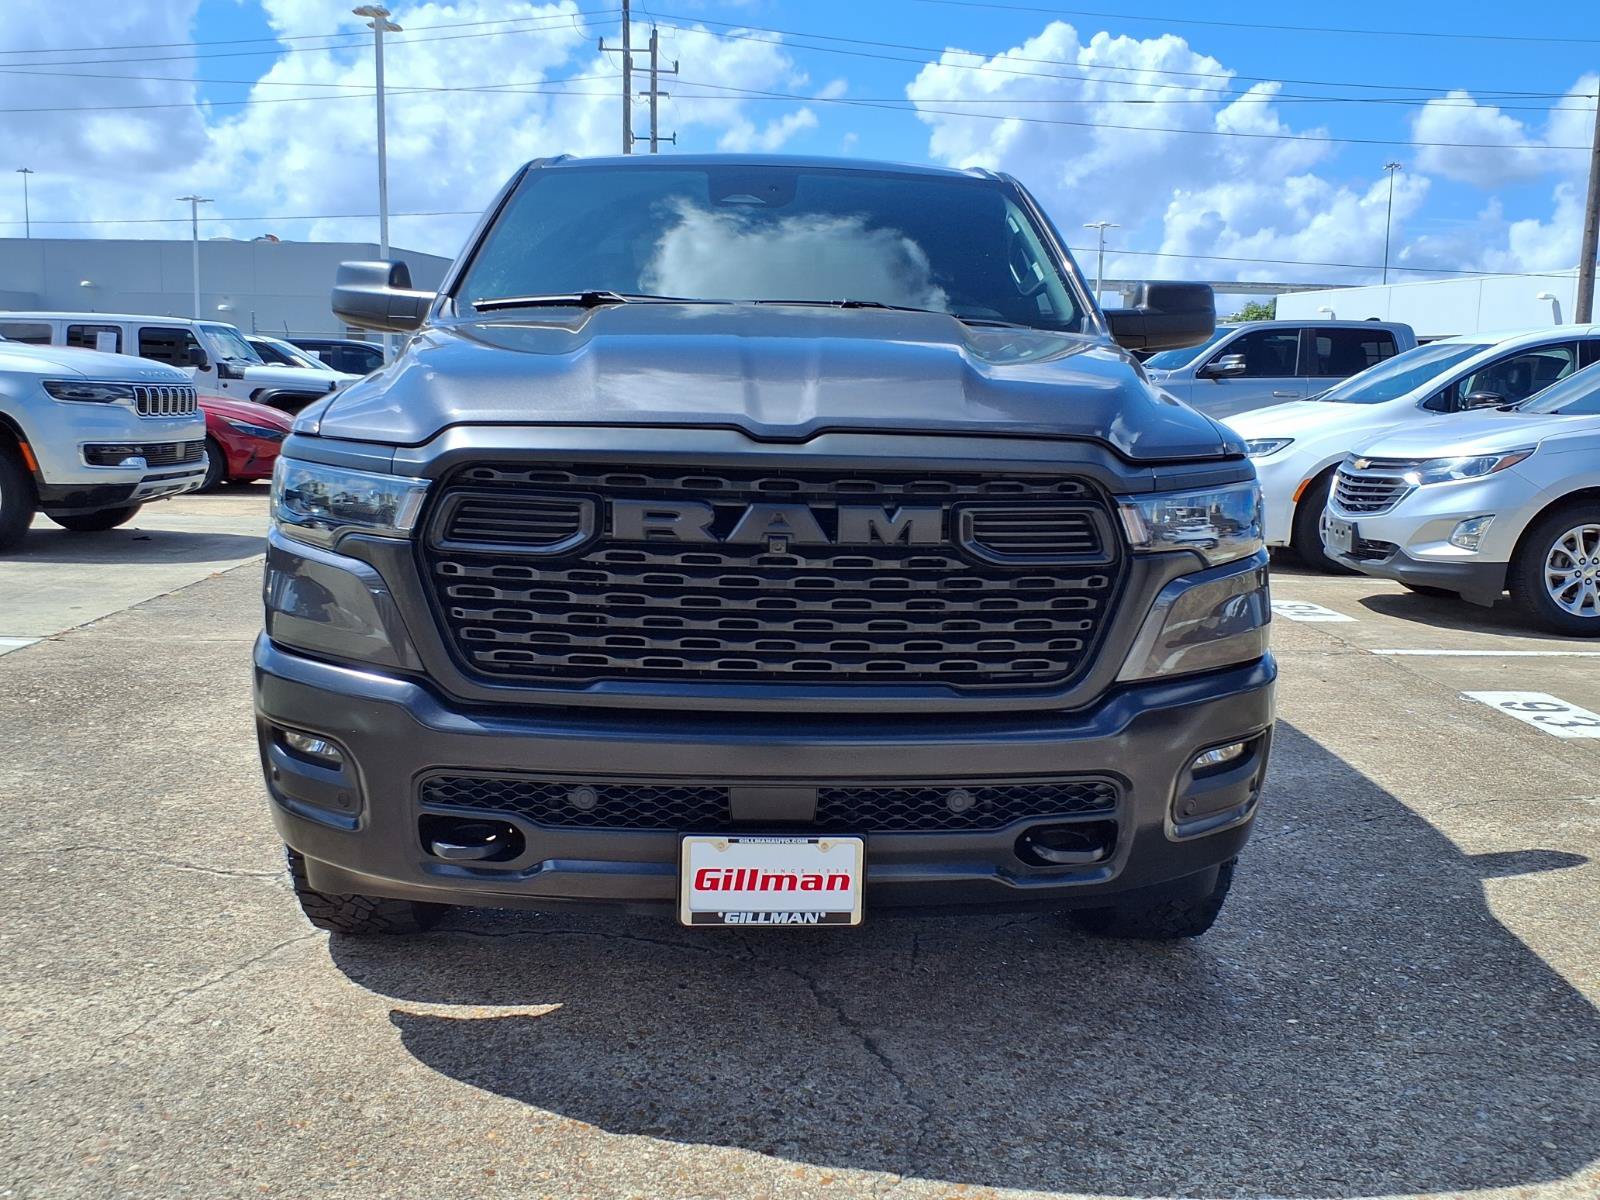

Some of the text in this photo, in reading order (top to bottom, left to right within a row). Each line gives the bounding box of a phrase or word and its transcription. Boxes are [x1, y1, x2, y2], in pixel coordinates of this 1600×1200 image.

[612, 499, 943, 545] RAM
[1499, 701, 1600, 727] 93
[694, 868, 850, 891] Gillman
[724, 911, 820, 924] GILLMAN
